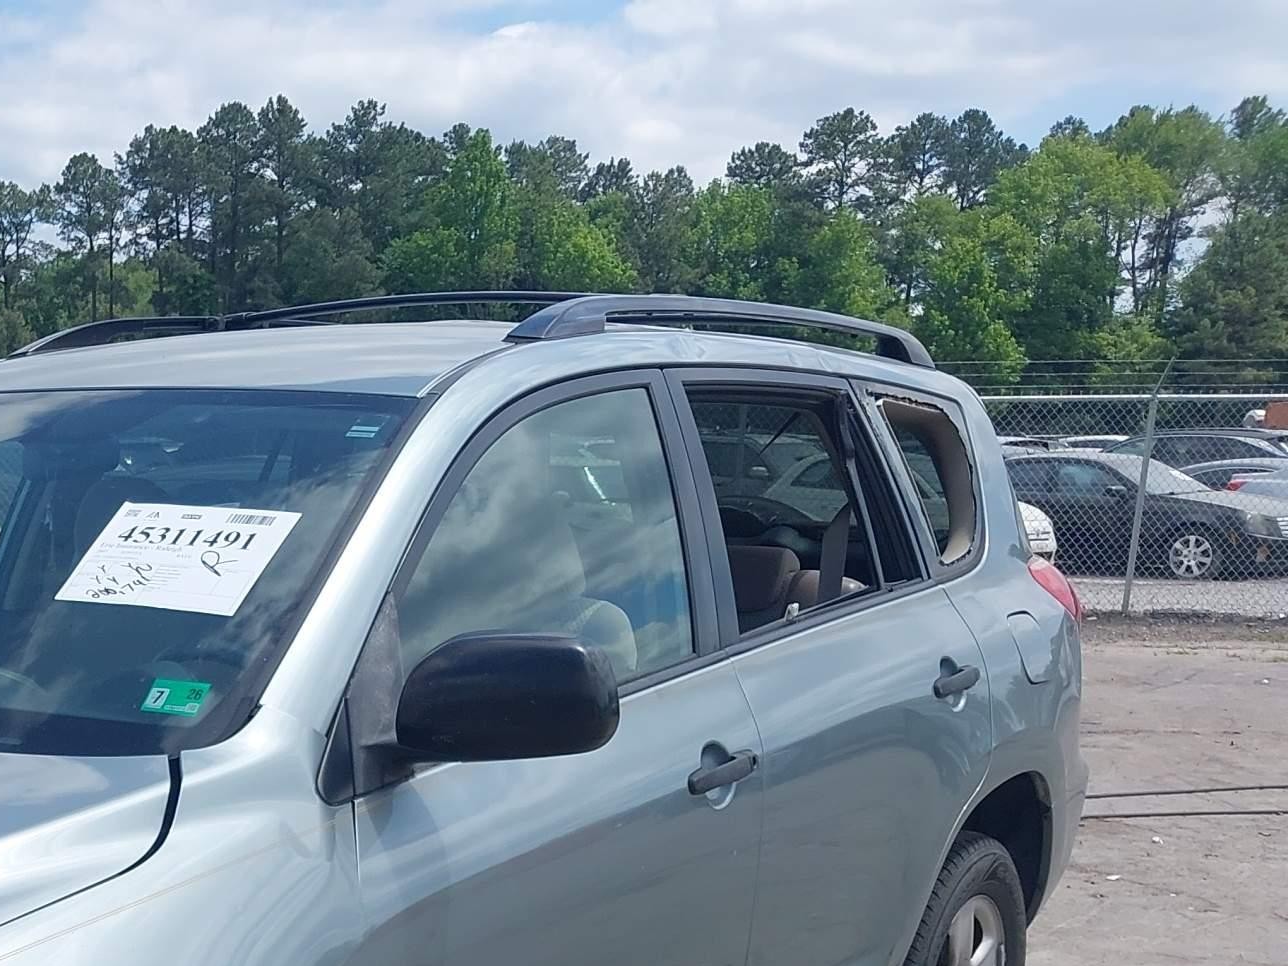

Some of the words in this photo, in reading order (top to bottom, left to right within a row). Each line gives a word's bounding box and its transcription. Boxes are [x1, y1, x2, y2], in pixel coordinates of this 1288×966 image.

[118, 526, 257, 550] 45311491
[152, 690, 166, 704] 7
[187, 688, 204, 701] 26
